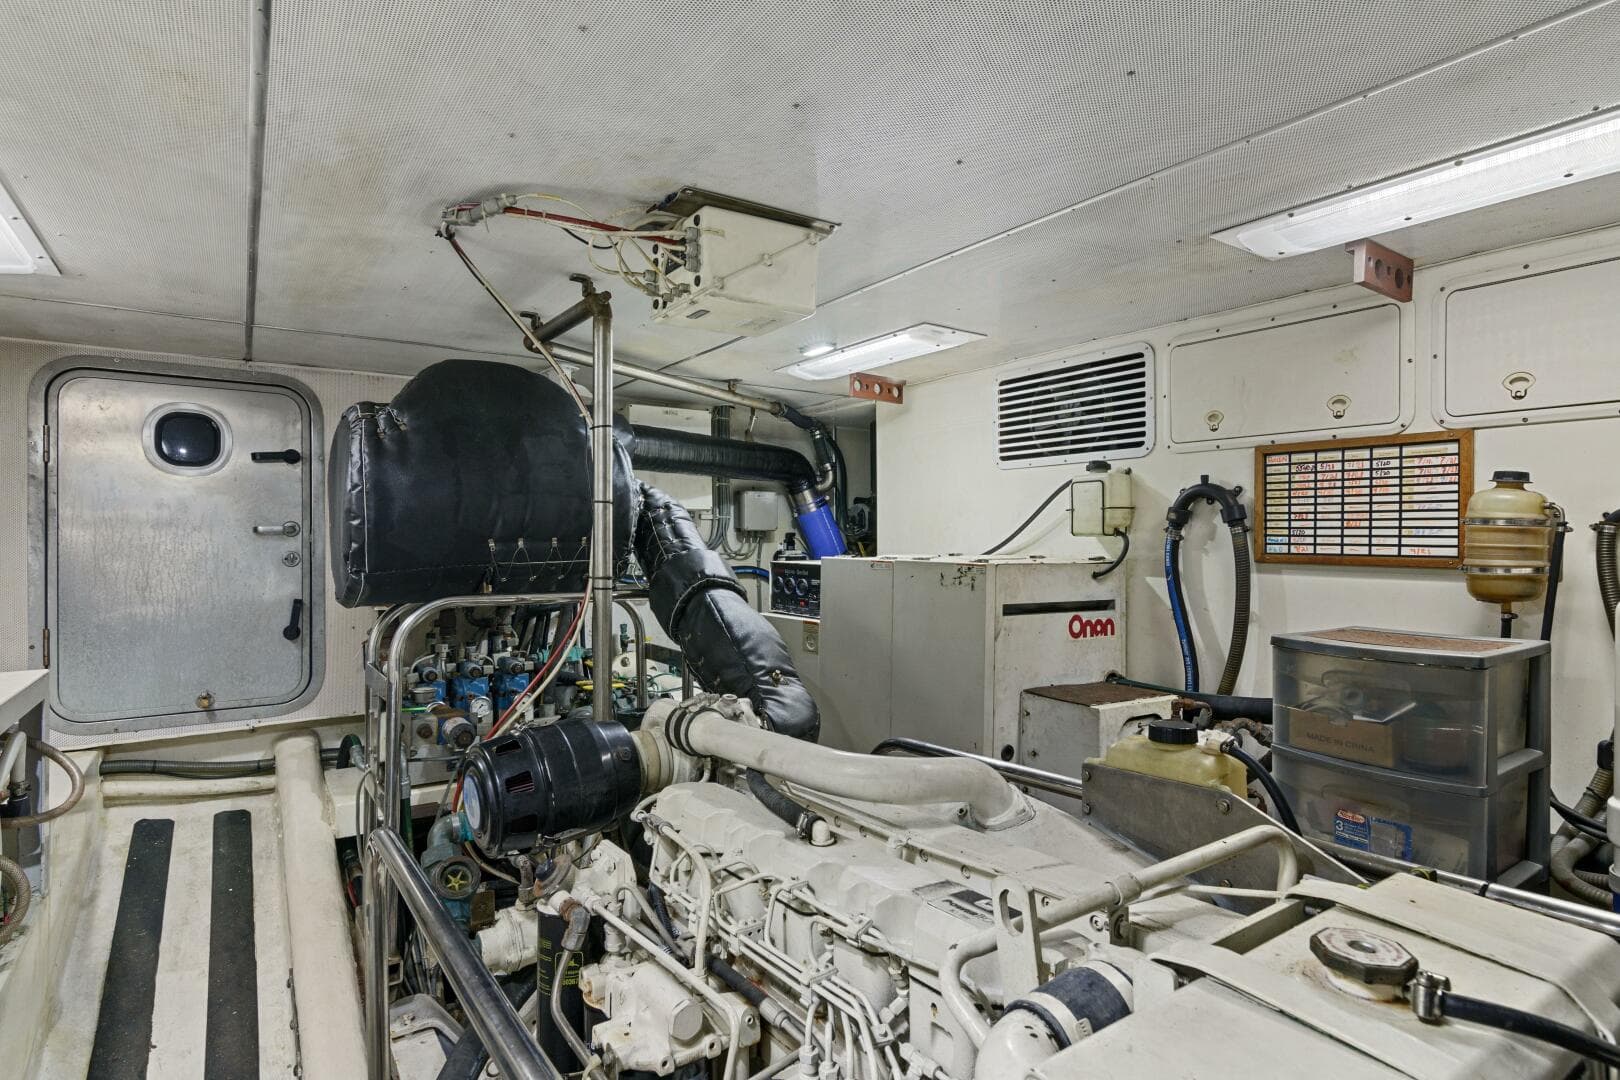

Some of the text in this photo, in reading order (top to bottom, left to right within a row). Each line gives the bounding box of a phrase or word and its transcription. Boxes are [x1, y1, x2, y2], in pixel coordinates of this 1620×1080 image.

[1068, 614, 1115, 639] Onan
[1306, 732, 1333, 743] MADE
[1345, 740, 1375, 753] CHINA
[1335, 820, 1343, 830] 3
